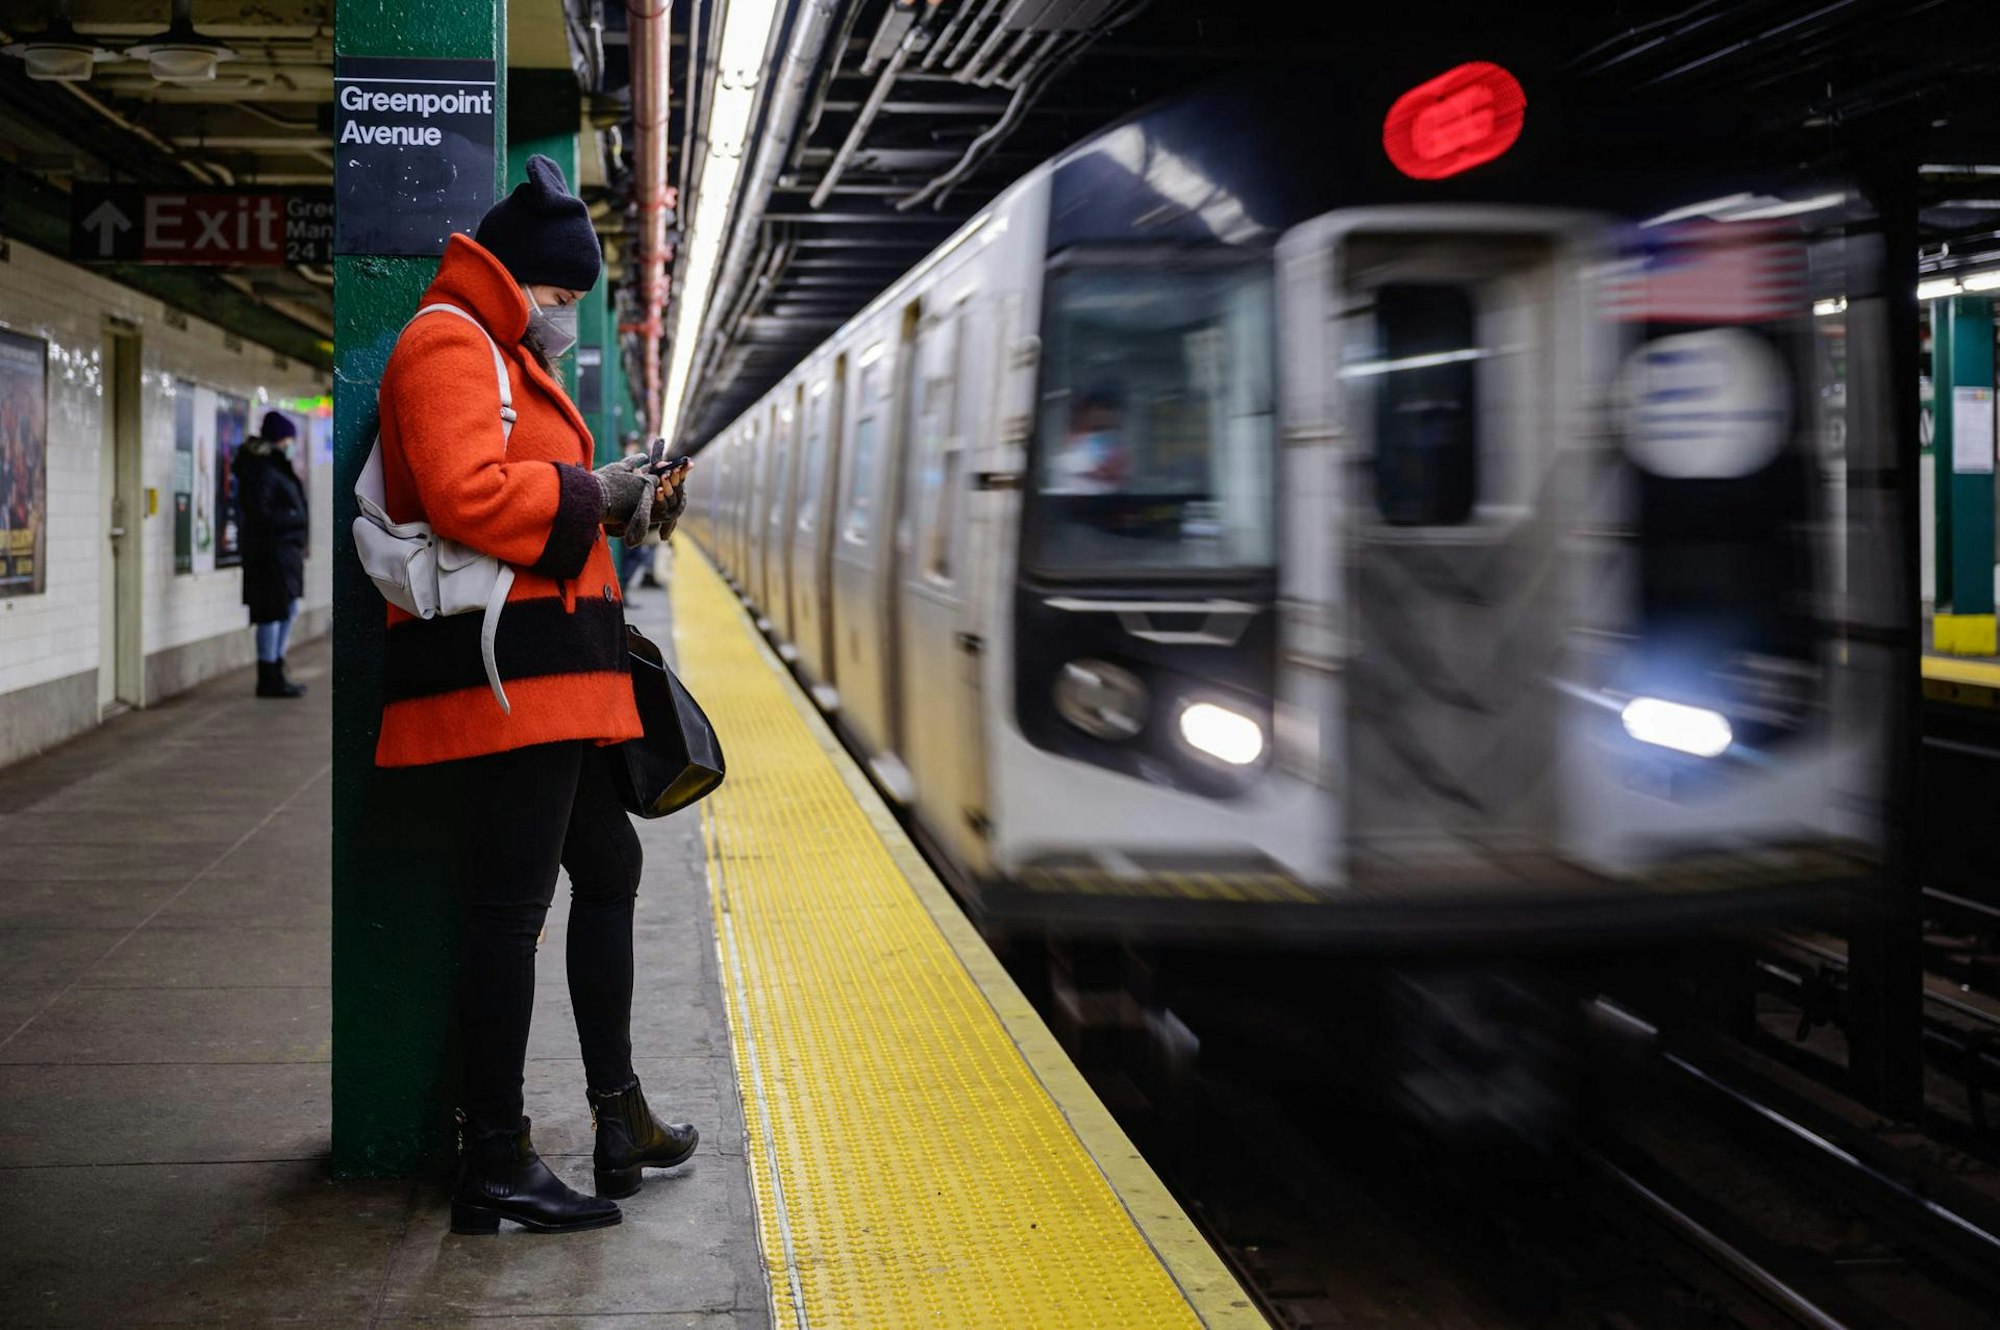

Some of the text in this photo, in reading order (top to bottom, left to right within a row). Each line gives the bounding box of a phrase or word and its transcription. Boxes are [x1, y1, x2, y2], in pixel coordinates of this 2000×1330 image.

[340, 85, 492, 118] Greenpoint
[340, 119, 442, 146] Avenue
[144, 195, 279, 251] Exit
[286, 240, 315, 260] 24
